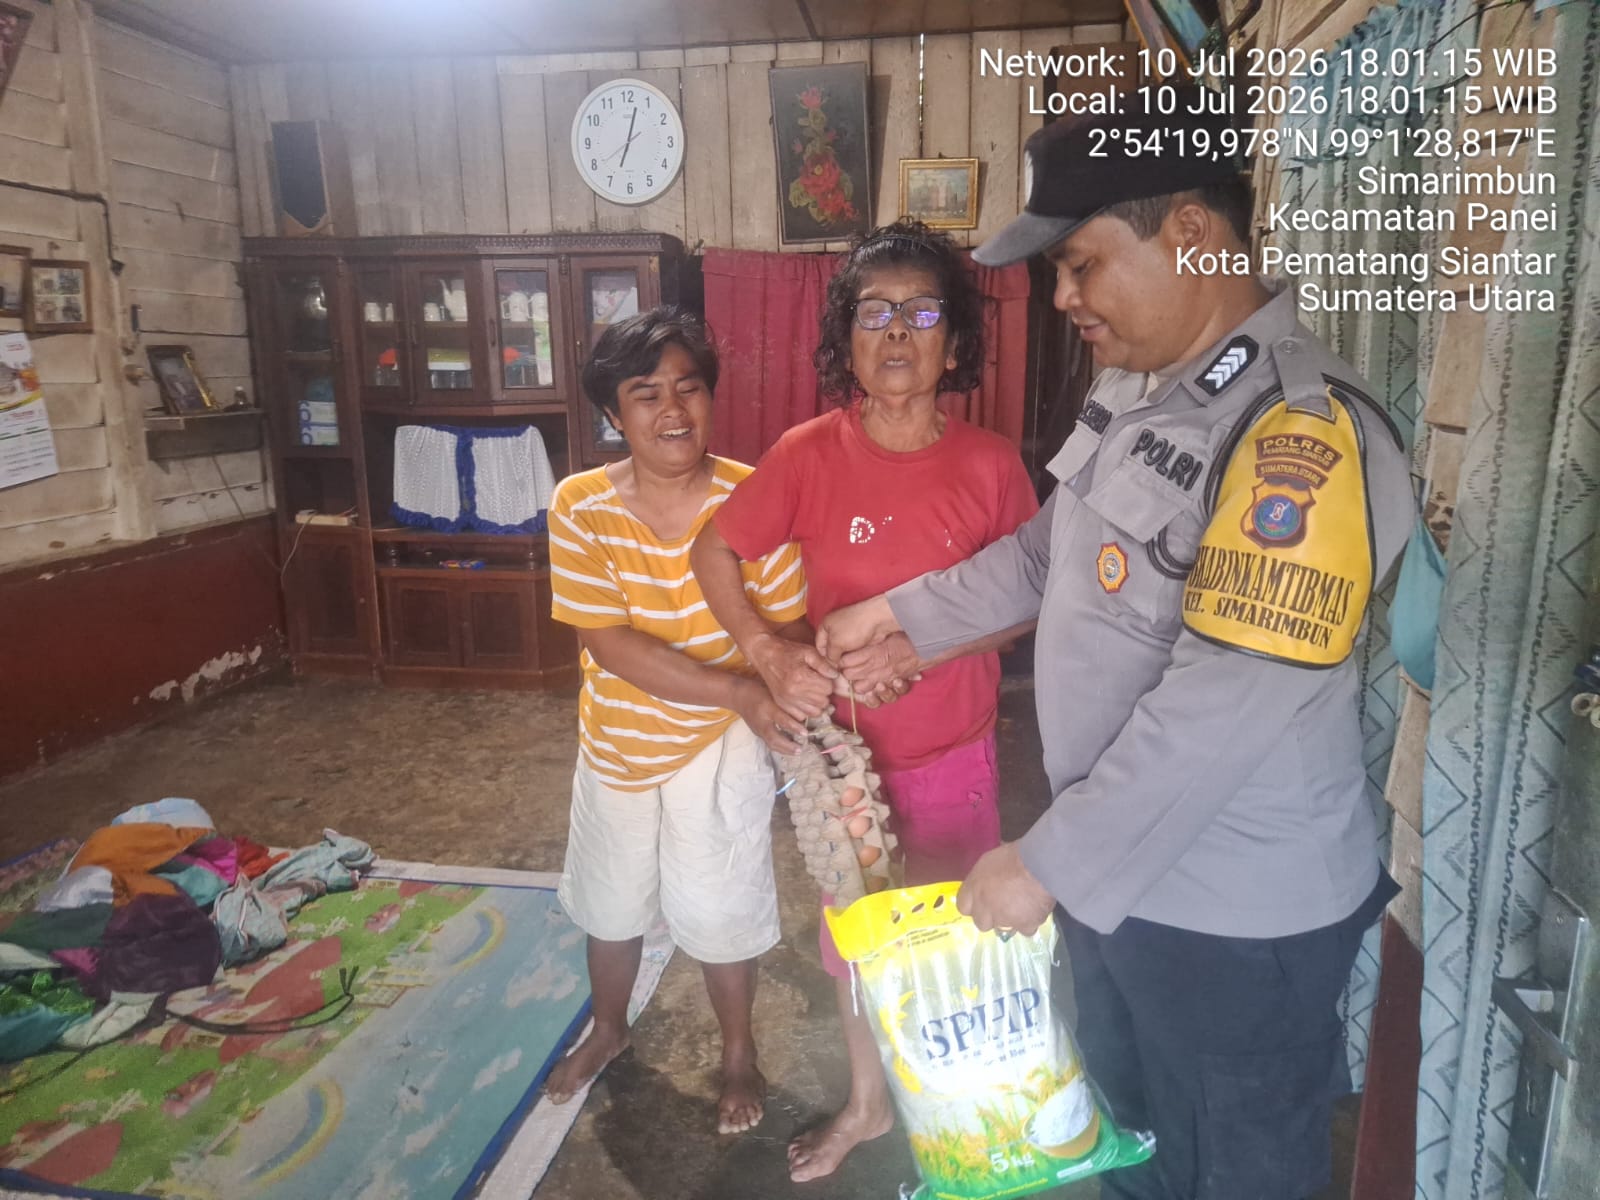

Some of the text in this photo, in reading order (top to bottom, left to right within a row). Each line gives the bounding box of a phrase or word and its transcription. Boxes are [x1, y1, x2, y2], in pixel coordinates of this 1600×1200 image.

[621, 90, 634, 103] 12
[601, 97, 613, 110] 11
[587, 114, 600, 127] 10
[660, 113, 667, 126] 2
[584, 137, 591, 150] 9
[667, 136, 674, 149] 3
[591, 158, 598, 171] 8
[661, 158, 667, 170] 4
[607, 175, 613, 188] 7
[646, 175, 653, 187] 5
[627, 182, 633, 195] 6
[1263, 437, 1335, 461] POLRES
[1130, 428, 1203, 491] POLRI
[1213, 596, 1334, 650] SIMARIMBUN
